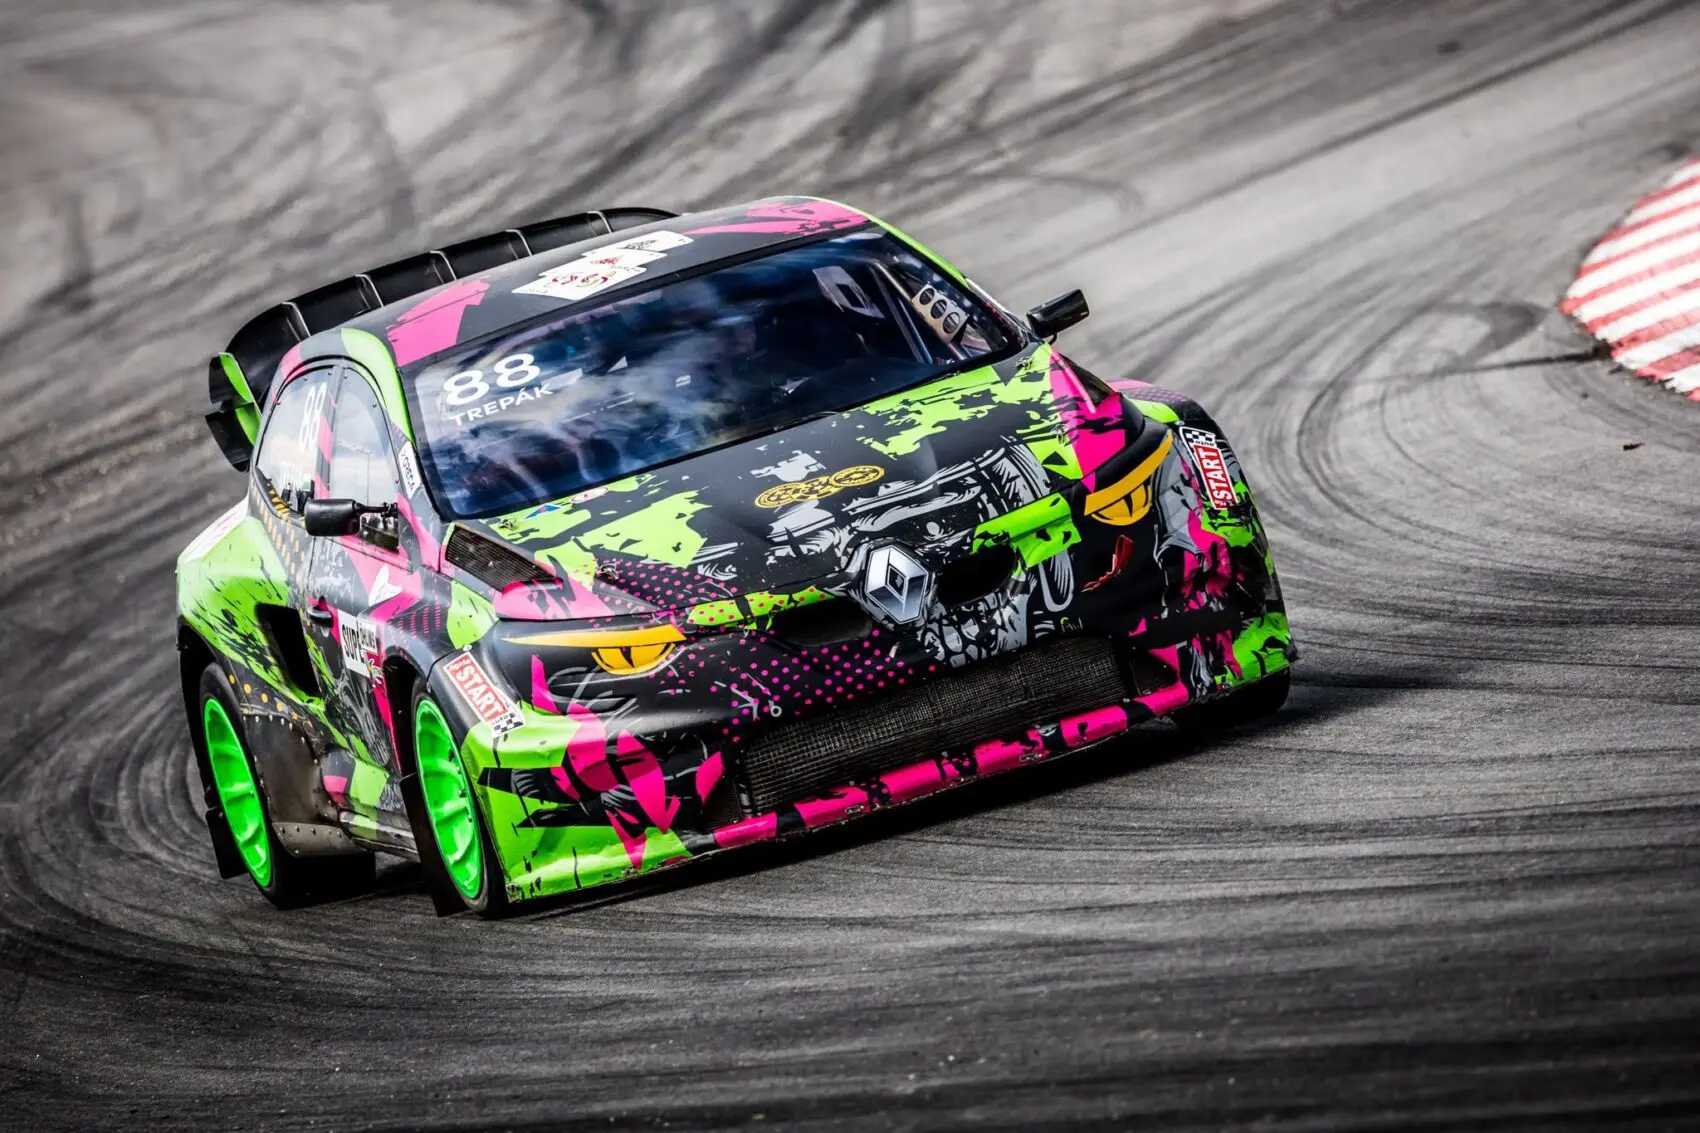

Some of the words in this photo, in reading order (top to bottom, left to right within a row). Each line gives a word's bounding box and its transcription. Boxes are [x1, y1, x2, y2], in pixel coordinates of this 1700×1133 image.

[443, 353, 541, 405] 88
[449, 384, 553, 427] TREPÁK
[1198, 448, 1233, 500] START
[455, 665, 504, 719] START
